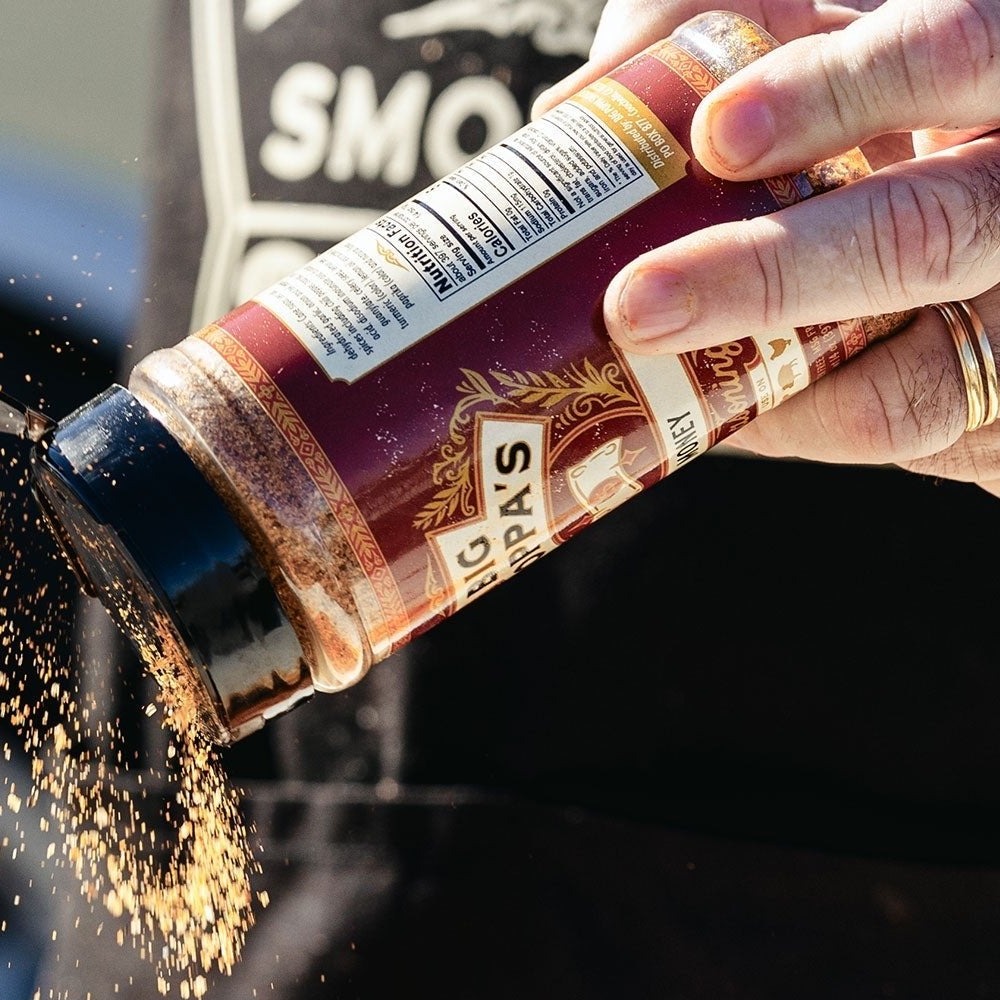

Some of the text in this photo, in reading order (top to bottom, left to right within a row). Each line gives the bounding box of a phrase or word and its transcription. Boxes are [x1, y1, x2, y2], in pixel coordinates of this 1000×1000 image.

[260, 61, 525, 187] SMO
[608, 110, 624, 122] BIG
[636, 118, 652, 131] 877
[626, 127, 664, 168] Distributed
[646, 128, 665, 146] BOX
[590, 147, 601, 158] Value
[604, 151, 614, 160] food
[615, 152, 626, 163] used
[660, 144, 674, 158] PO
[568, 160, 585, 176] added
[600, 157, 610, 168] Daily
[616, 164, 630, 180] serving
[628, 167, 637, 176] day
[549, 168, 573, 192] significant
[572, 178, 582, 188] fat,
[588, 169, 601, 180] and
[612, 172, 620, 182] The
[514, 178, 544, 210] Carbohydrate
[580, 187, 594, 203] trans
[584, 176, 602, 197] sugars,
[598, 180, 610, 193] iron
[542, 189, 568, 219] Protein 0g
[573, 196, 585, 208] Not
[505, 207, 532, 241] Total Fat 0g
[510, 193, 545, 234] Sodium 115mg
[541, 210, 556, 227] Total
[416, 228, 439, 250] servings
[450, 214, 494, 264] Amount per serving
[468, 212, 507, 257] Calories
[376, 219, 452, 294] Nutrition Facts
[434, 250, 450, 263] 397
[440, 234, 476, 277] Serving size
[372, 267, 394, 286] (color)
[446, 261, 466, 282] about
[390, 284, 414, 309] paprika
[332, 306, 358, 336] including
[343, 300, 368, 324] disodium
[383, 299, 409, 329] turmeric
[307, 324, 336, 356] Ingredients:
[326, 323, 358, 360] dehydrated
[354, 333, 373, 355] spices
[809, 336, 822, 355] MSG
[756, 378, 766, 392] ON
[667, 412, 698, 466] MONEY
[457, 536, 498, 597] BIG
